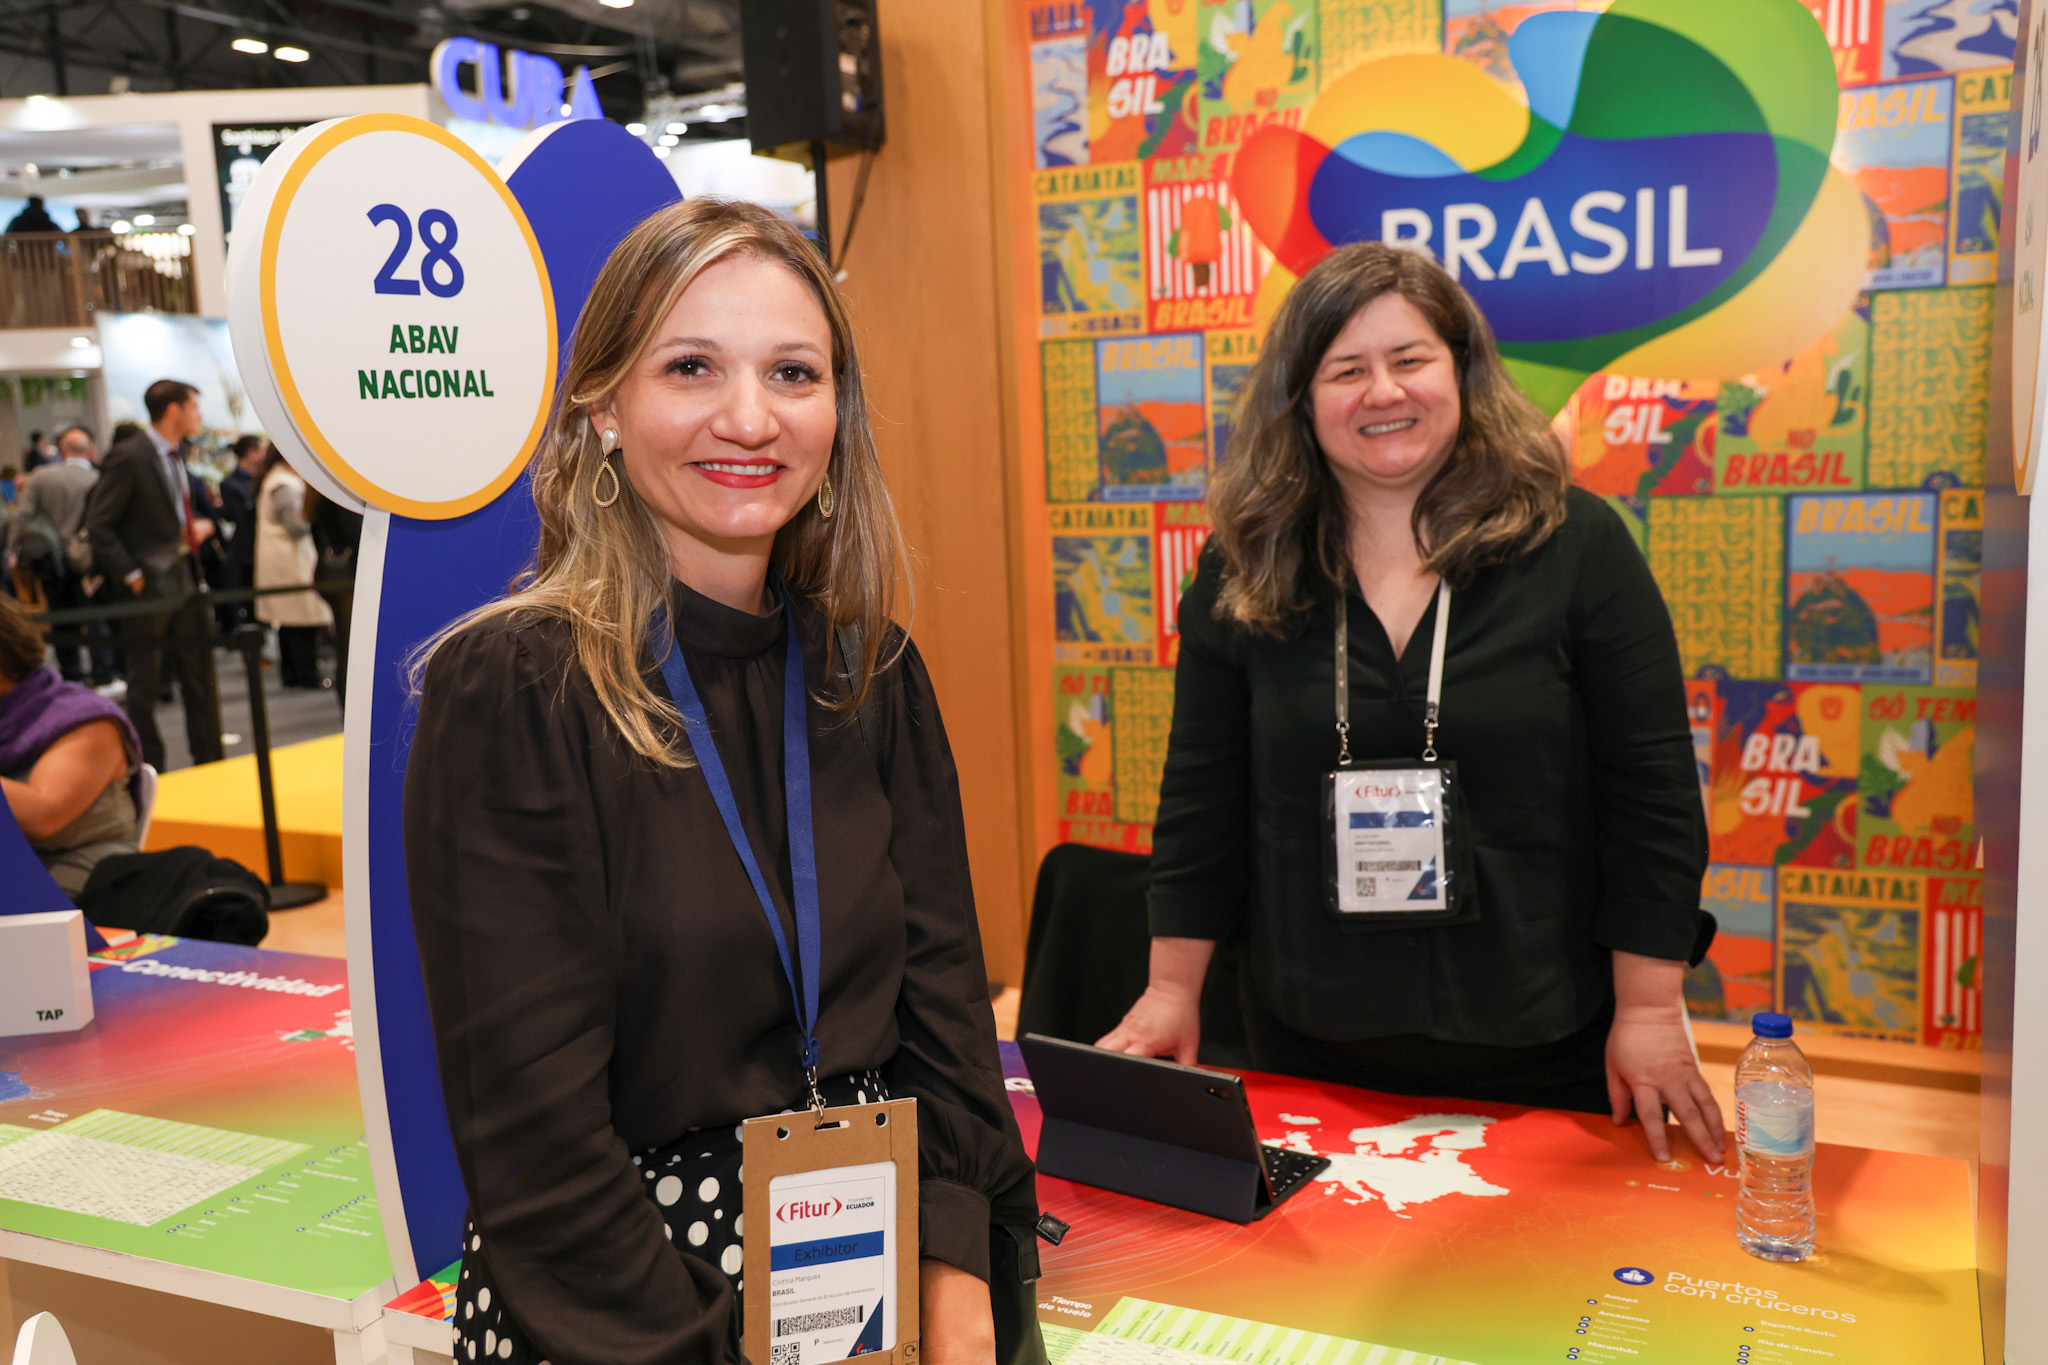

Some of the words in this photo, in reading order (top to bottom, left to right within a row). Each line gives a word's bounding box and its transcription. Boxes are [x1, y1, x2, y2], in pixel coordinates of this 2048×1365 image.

[1106, 32, 1170, 77] BRA
[432, 36, 605, 129] CUBA
[1107, 76, 1164, 119] SIL
[1838, 86, 1945, 131] RASIL
[1381, 184, 1722, 281] BRASIL
[367, 204, 464, 298] 28
[1154, 297, 1254, 329] BRASIL
[390, 324, 458, 354] ABAV
[1102, 338, 1199, 372] BRASIL
[358, 369, 494, 400] NACIONAL
[1604, 404, 1673, 445] SIL
[1722, 451, 1852, 487] BRASIL
[1795, 497, 1930, 534] BRASIL
[1740, 733, 1821, 775] BRA
[1065, 789, 1113, 816] BRA
[1364, 785, 1395, 797] Fitur
[1740, 777, 1811, 819] SIL
[1865, 834, 1975, 872] BRASI
[1700, 867, 1770, 903] ASIL
[122, 959, 345, 997] Conectividad
[36, 1009, 64, 1021] TAP
[1737, 1101, 1746, 1145] Vitalis
[790, 1200, 831, 1221] Fitur
[846, 1201, 875, 1210] ECUADOR
[795, 1242, 858, 1262] Exhibitor
[772, 1278, 794, 1287] Cinthia
[795, 1274, 821, 1283] Marques
[772, 1288, 796, 1297] BRASIL
[1667, 1272, 1778, 1300] Puertos
[1038, 1302, 1054, 1310] de
[1057, 1306, 1092, 1318] vuelo
[1051, 1295, 1092, 1310] Tiempo
[1598, 1310, 1650, 1324] Amazonas
[1664, 1283, 1717, 1300] con
[1725, 1293, 1856, 1323] cruceros
[1587, 1341, 1639, 1355] Maranhão
[1757, 1338, 1775, 1347] Rio
[1791, 1344, 1834, 1357] Janeiro
[1803, 1328, 1837, 1338] Santo
